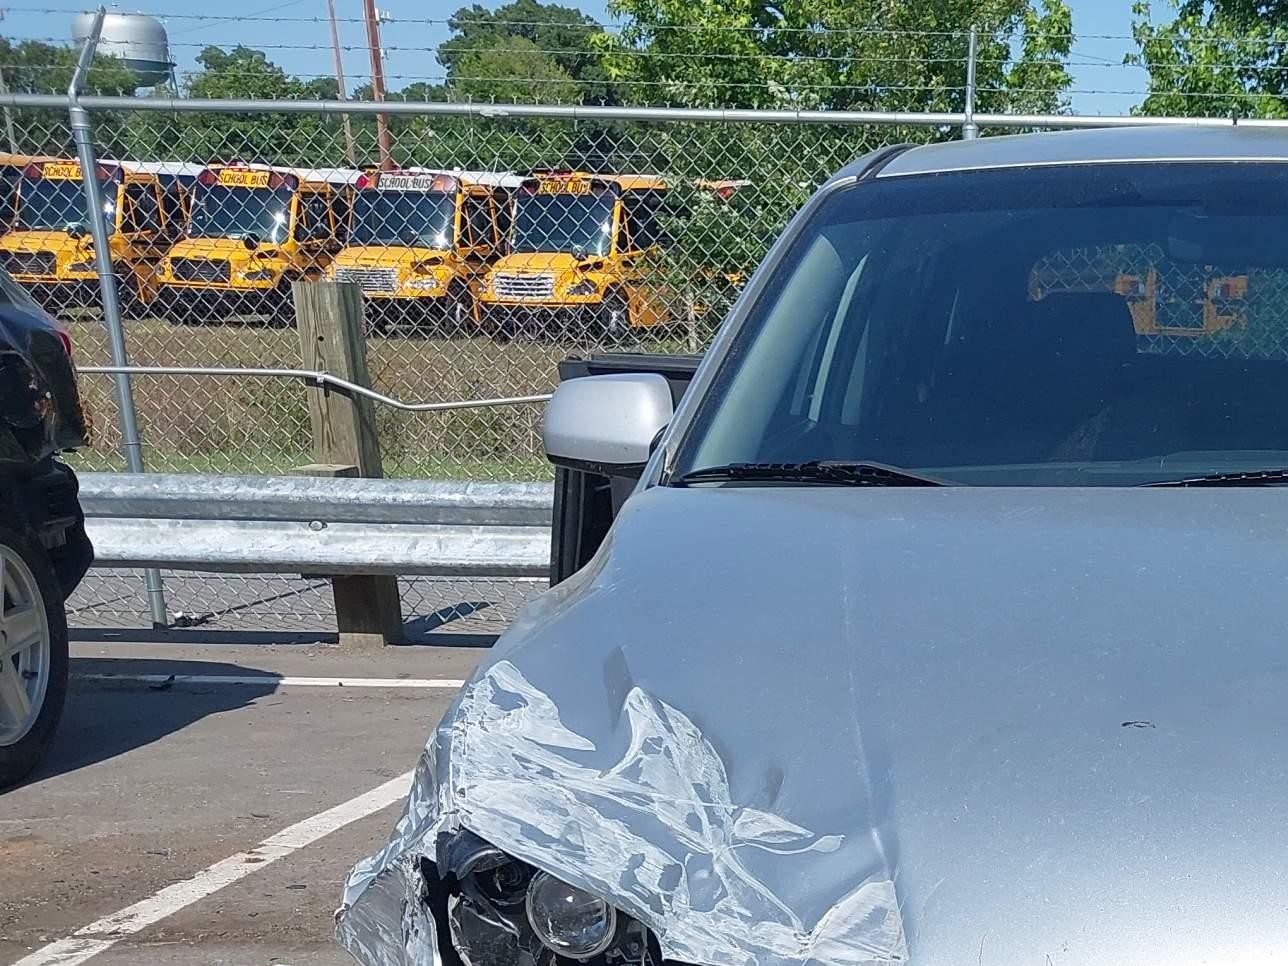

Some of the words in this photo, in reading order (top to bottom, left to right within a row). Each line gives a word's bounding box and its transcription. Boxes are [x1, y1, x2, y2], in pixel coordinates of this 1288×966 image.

[219, 172, 248, 184] SCHOOL
[250, 175, 268, 185] BUS
[379, 177, 411, 188] SCHOOL
[412, 179, 431, 189] BUS
